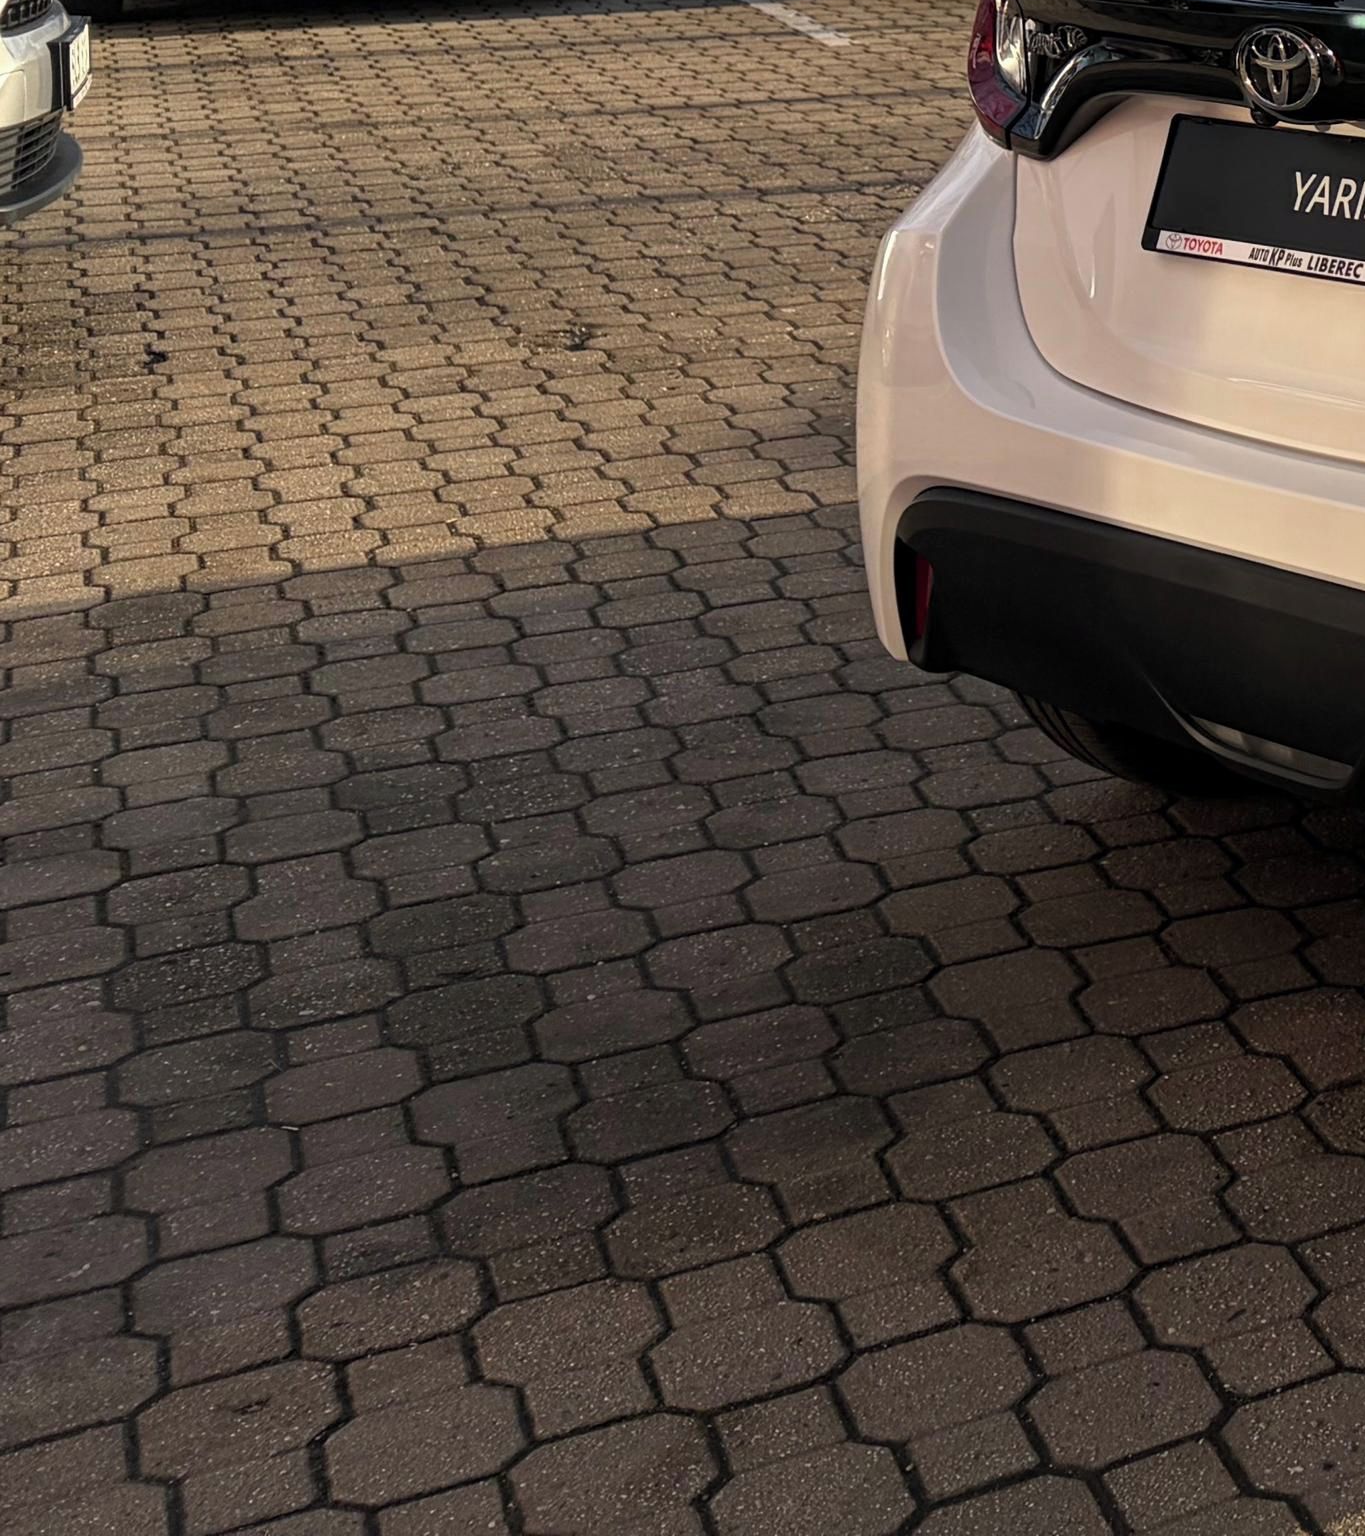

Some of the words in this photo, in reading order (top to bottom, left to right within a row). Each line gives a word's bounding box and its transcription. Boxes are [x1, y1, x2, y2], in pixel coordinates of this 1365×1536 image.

[1183, 236, 1224, 257] TOYOTA
[1248, 247, 1270, 263] AUTO
[1268, 246, 1286, 267] KP
[1285, 252, 1303, 268] Plus
[1306, 255, 1365, 279] LIBEREC
